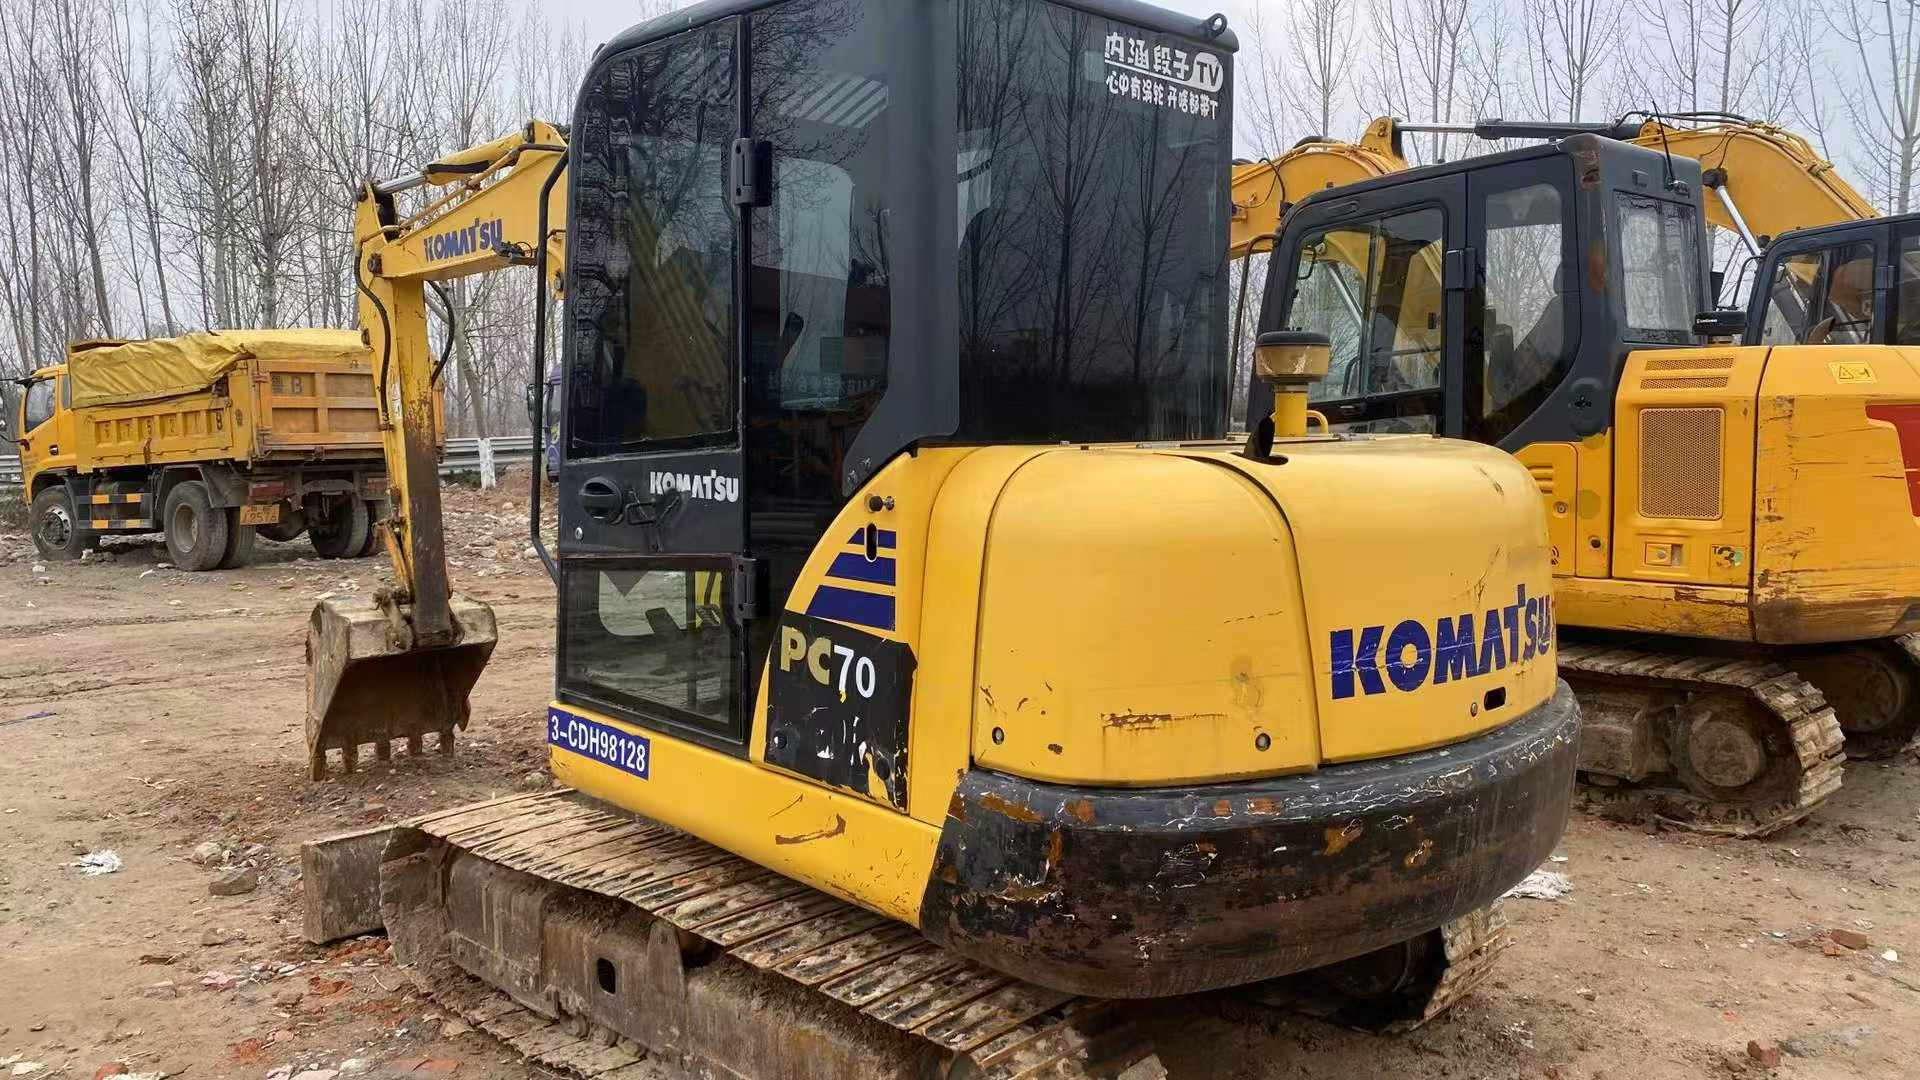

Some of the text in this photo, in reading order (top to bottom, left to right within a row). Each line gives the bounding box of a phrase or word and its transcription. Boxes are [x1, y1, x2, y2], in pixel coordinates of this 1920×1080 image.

[424, 217, 502, 263] KOMATSU
[649, 469, 739, 503] KOMATSU
[1330, 583, 1552, 700] KOMATSU
[551, 715, 646, 773] 3-CDH98128
